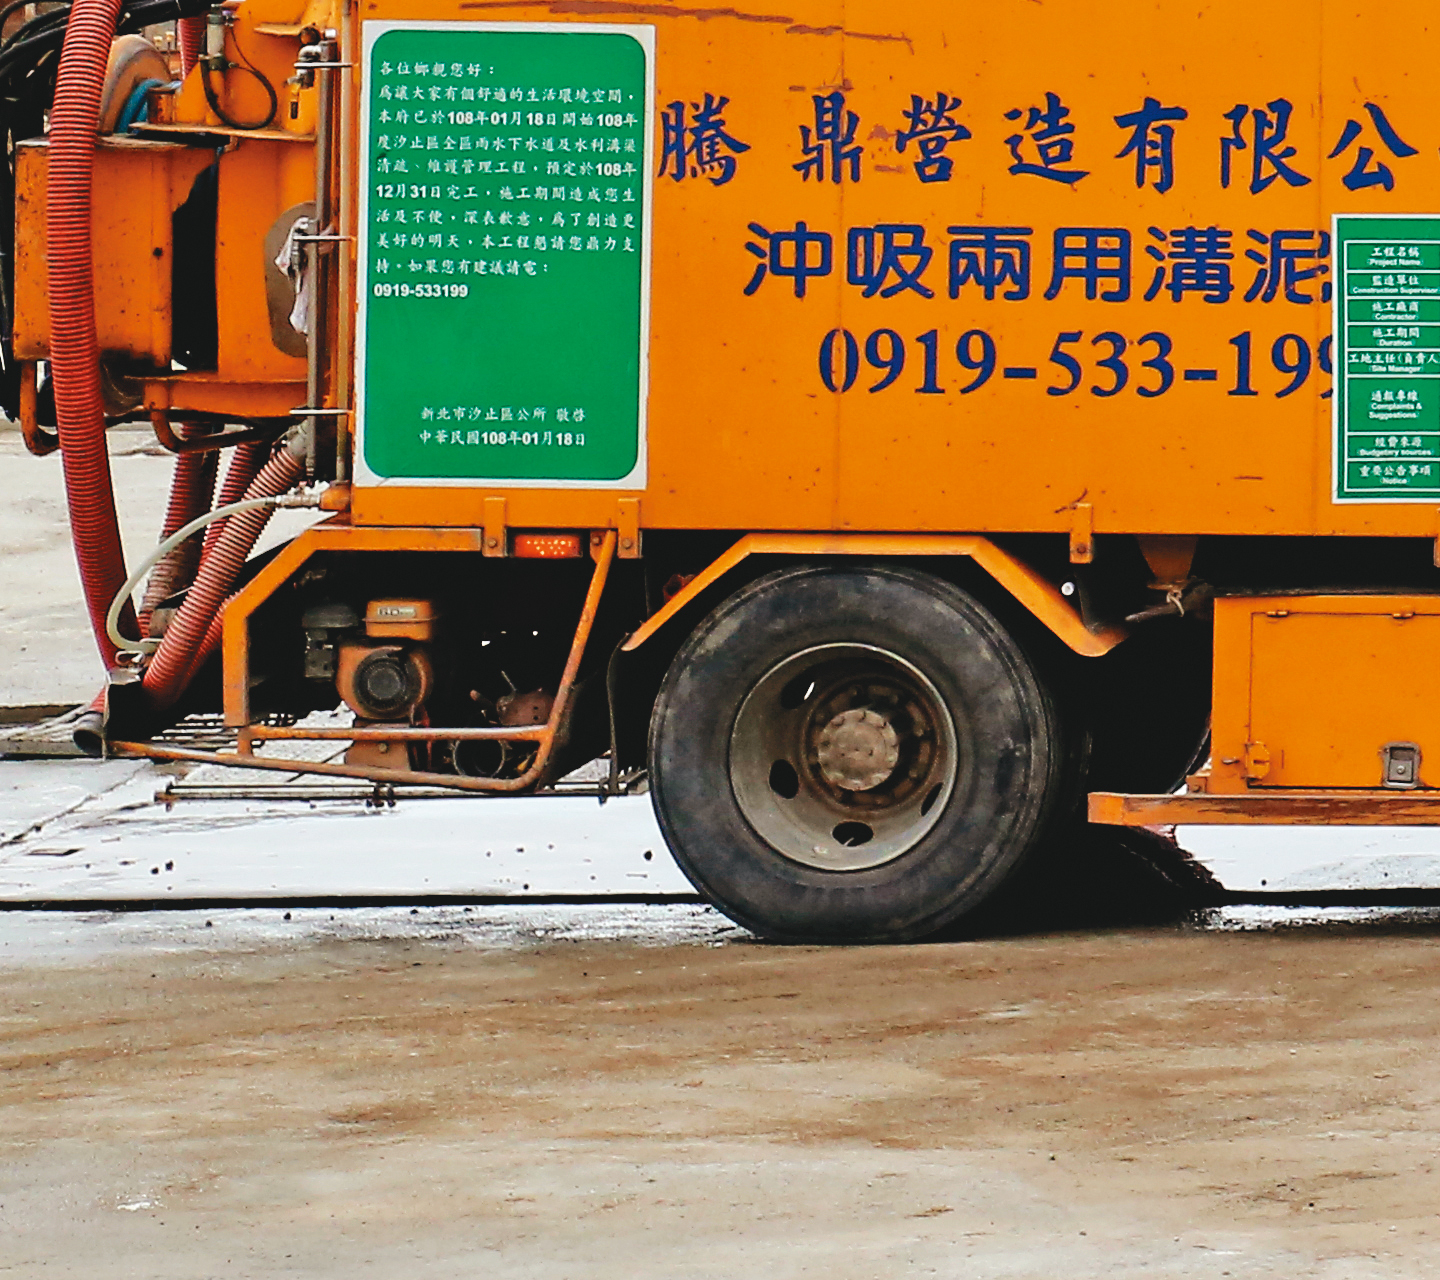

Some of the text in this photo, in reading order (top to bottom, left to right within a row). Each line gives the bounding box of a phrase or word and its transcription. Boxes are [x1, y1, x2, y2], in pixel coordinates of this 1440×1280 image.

[378, 135, 636, 154] 度汐止區全區雨水下水道及水利溝渠
[1371, 247, 1420, 258] 工程名稱
[1372, 274, 1420, 286] 監造單位
[374, 283, 468, 298] 0919-533199
[1372, 301, 1420, 313] 施工廠商
[1372, 327, 1420, 338] 施工期間
[421, 406, 546, 422] 新北市汐止區公所
[420, 430, 585, 446] 中華民國108年01月18日
[1359, 465, 1431, 477] 重要公告事項
